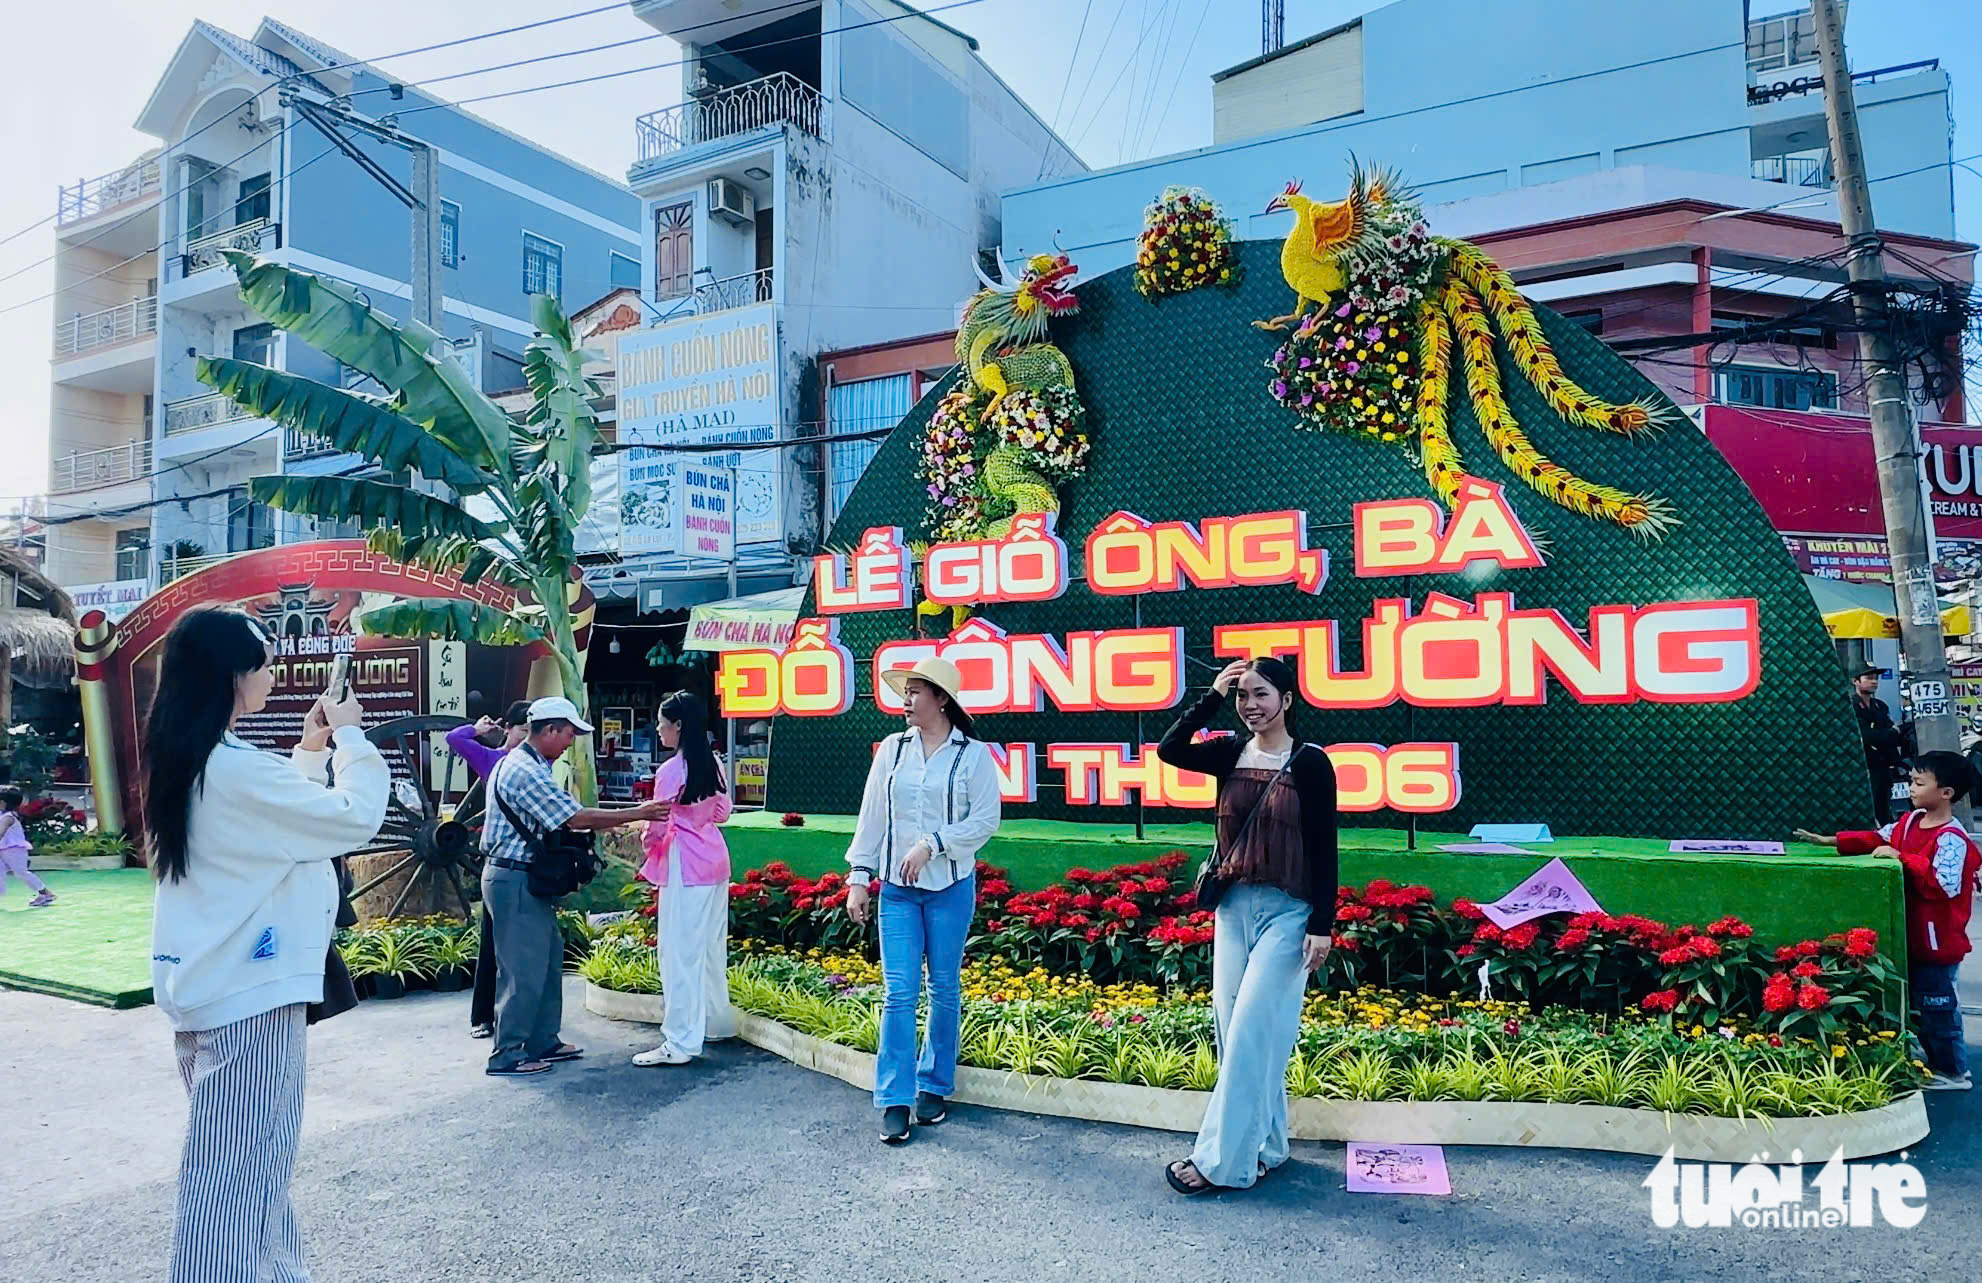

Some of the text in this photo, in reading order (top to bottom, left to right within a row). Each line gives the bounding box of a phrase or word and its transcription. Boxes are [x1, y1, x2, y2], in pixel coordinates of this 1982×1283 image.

[715, 375, 737, 405] HÀ
[742, 369, 771, 403] NỘI
[686, 470, 730, 492] BÚN CHẢ
[691, 492, 726, 515] HÀ NỘI
[818, 482, 1536, 607] LỄ GIỖ ÔNG, BÀ
[117, 588, 142, 602] MAI
[717, 621, 844, 714] ĐỖ
